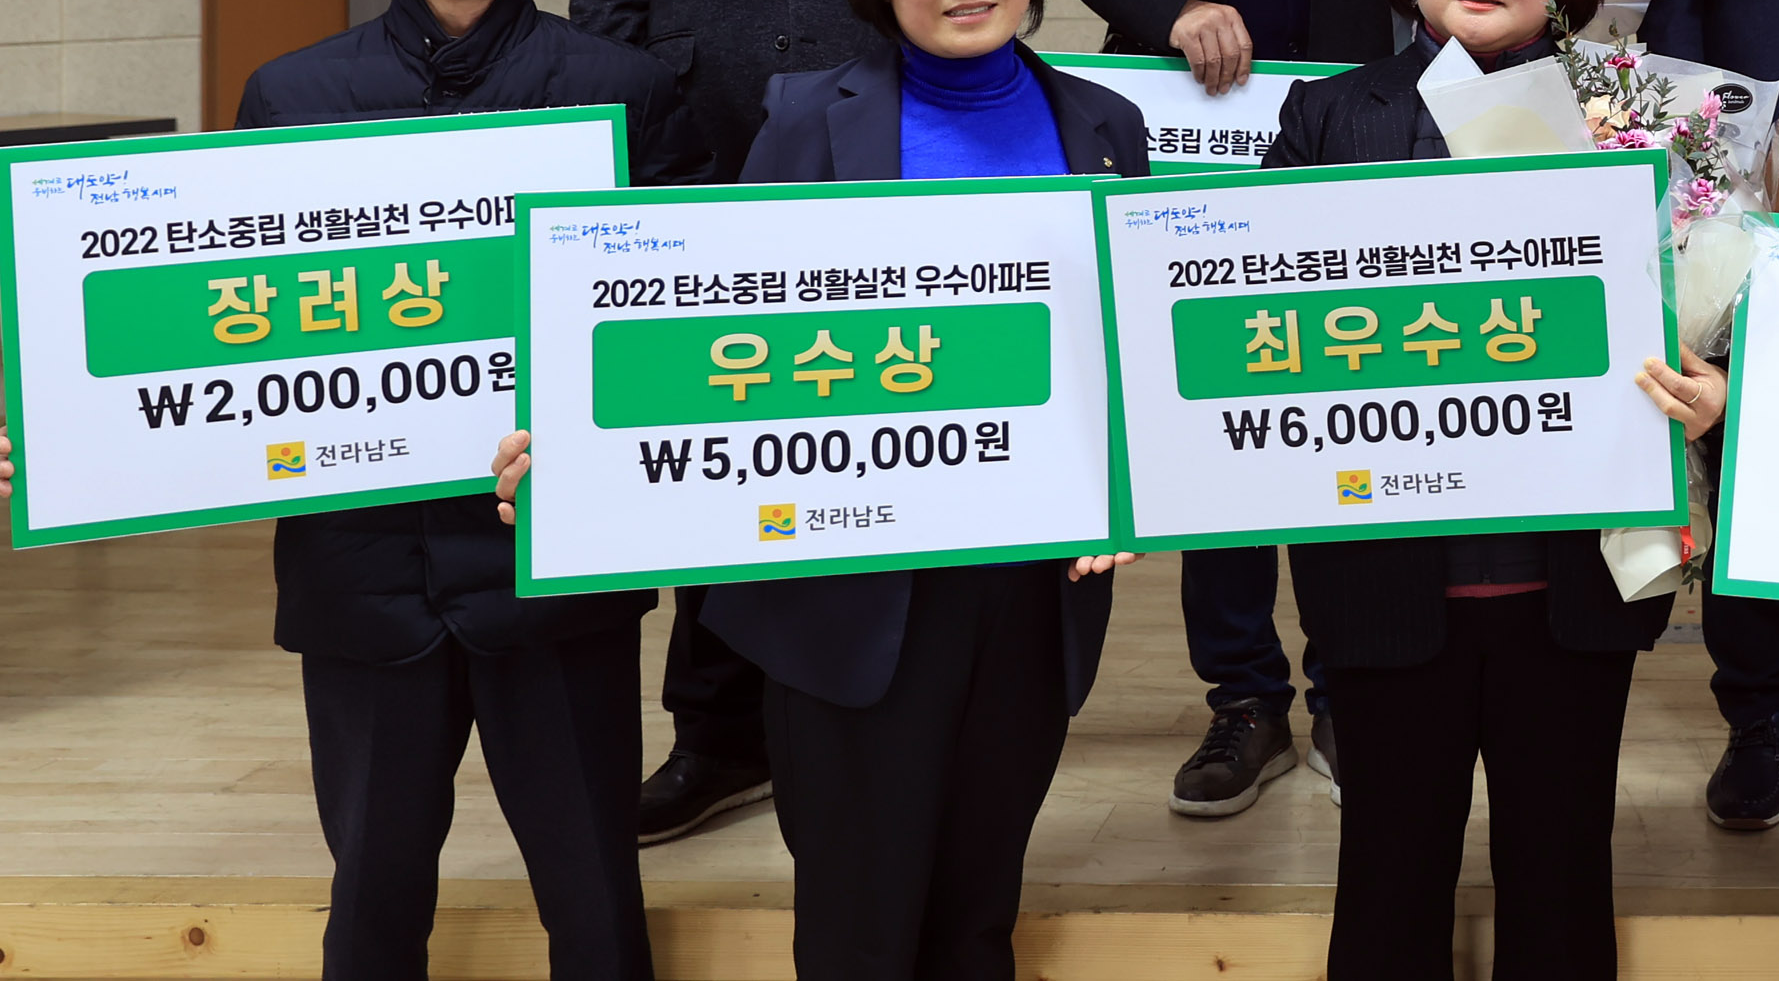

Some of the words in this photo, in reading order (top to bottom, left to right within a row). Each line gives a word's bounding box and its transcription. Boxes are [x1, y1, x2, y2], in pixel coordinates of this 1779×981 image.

[1207, 129, 1280, 157] 생활실
[90, 191, 119, 205] 전남
[80, 226, 159, 259] 2022
[166, 213, 286, 254] 탄소중립
[294, 203, 410, 243] 생활실천
[1175, 223, 1200, 236] 전남
[604, 240, 630, 254] 전남
[1168, 257, 1237, 288] 2022
[1242, 248, 1348, 286] 탄소중립
[1355, 242, 1462, 279] 생활실천
[1470, 235, 1604, 272] 우수아파트
[592, 277, 666, 309] 2022
[674, 271, 786, 307] 탄소중립
[795, 266, 906, 302] 생활실천
[915, 261, 1051, 297] 우수아파트
[206, 258, 451, 345] 장려상
[1244, 295, 1543, 374] 최우수상
[708, 324, 941, 401] 우수상
[315, 437, 410, 468] 전라남도
[1380, 472, 1466, 496] 전라남도
[805, 504, 896, 531] 전라남도
